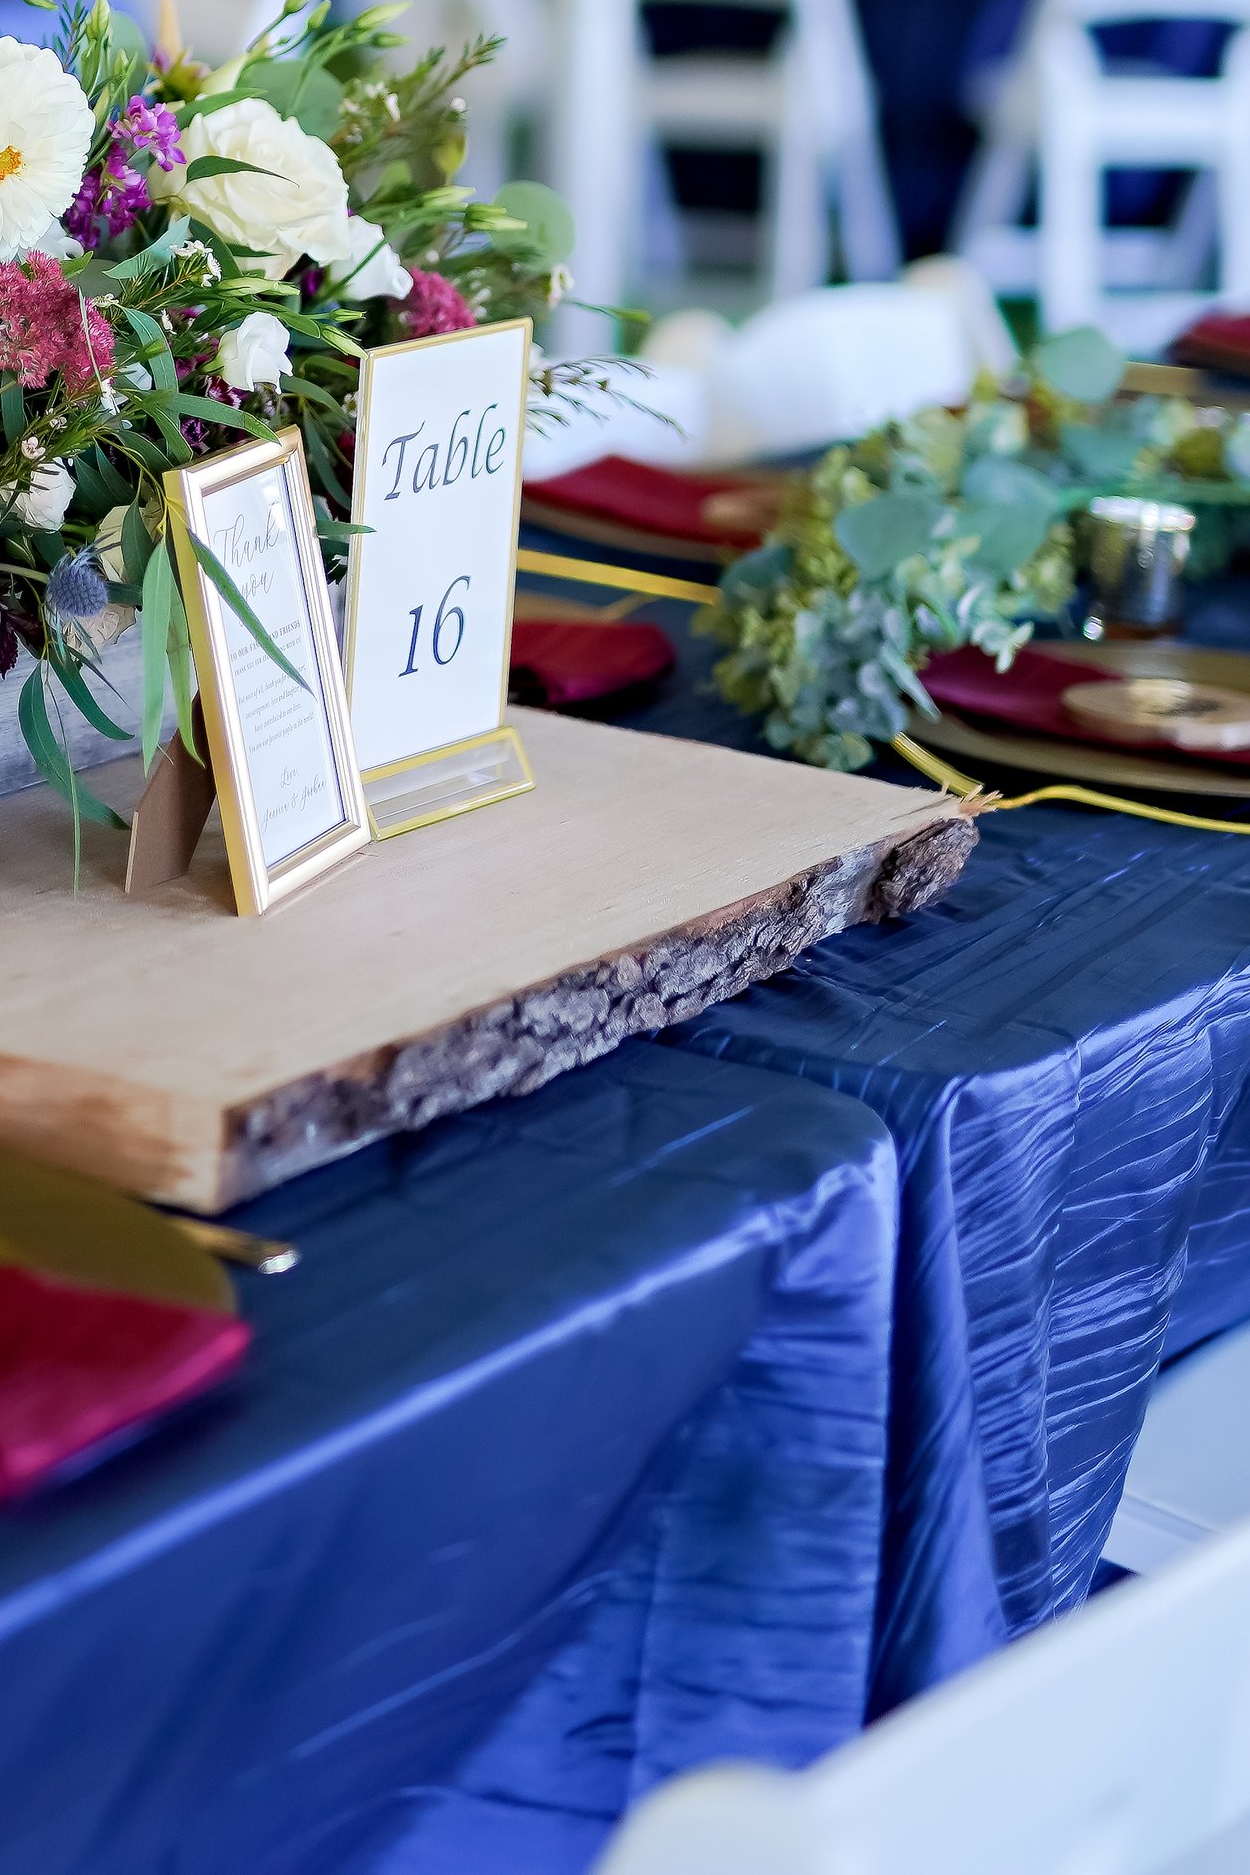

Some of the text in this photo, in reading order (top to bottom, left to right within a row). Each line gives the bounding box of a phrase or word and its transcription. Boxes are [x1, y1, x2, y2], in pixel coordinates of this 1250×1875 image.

[382, 402, 506, 502] Table
[213, 500, 281, 568] Thank
[279, 619, 301, 637] FRIENDS
[397, 575, 471, 678] 16
